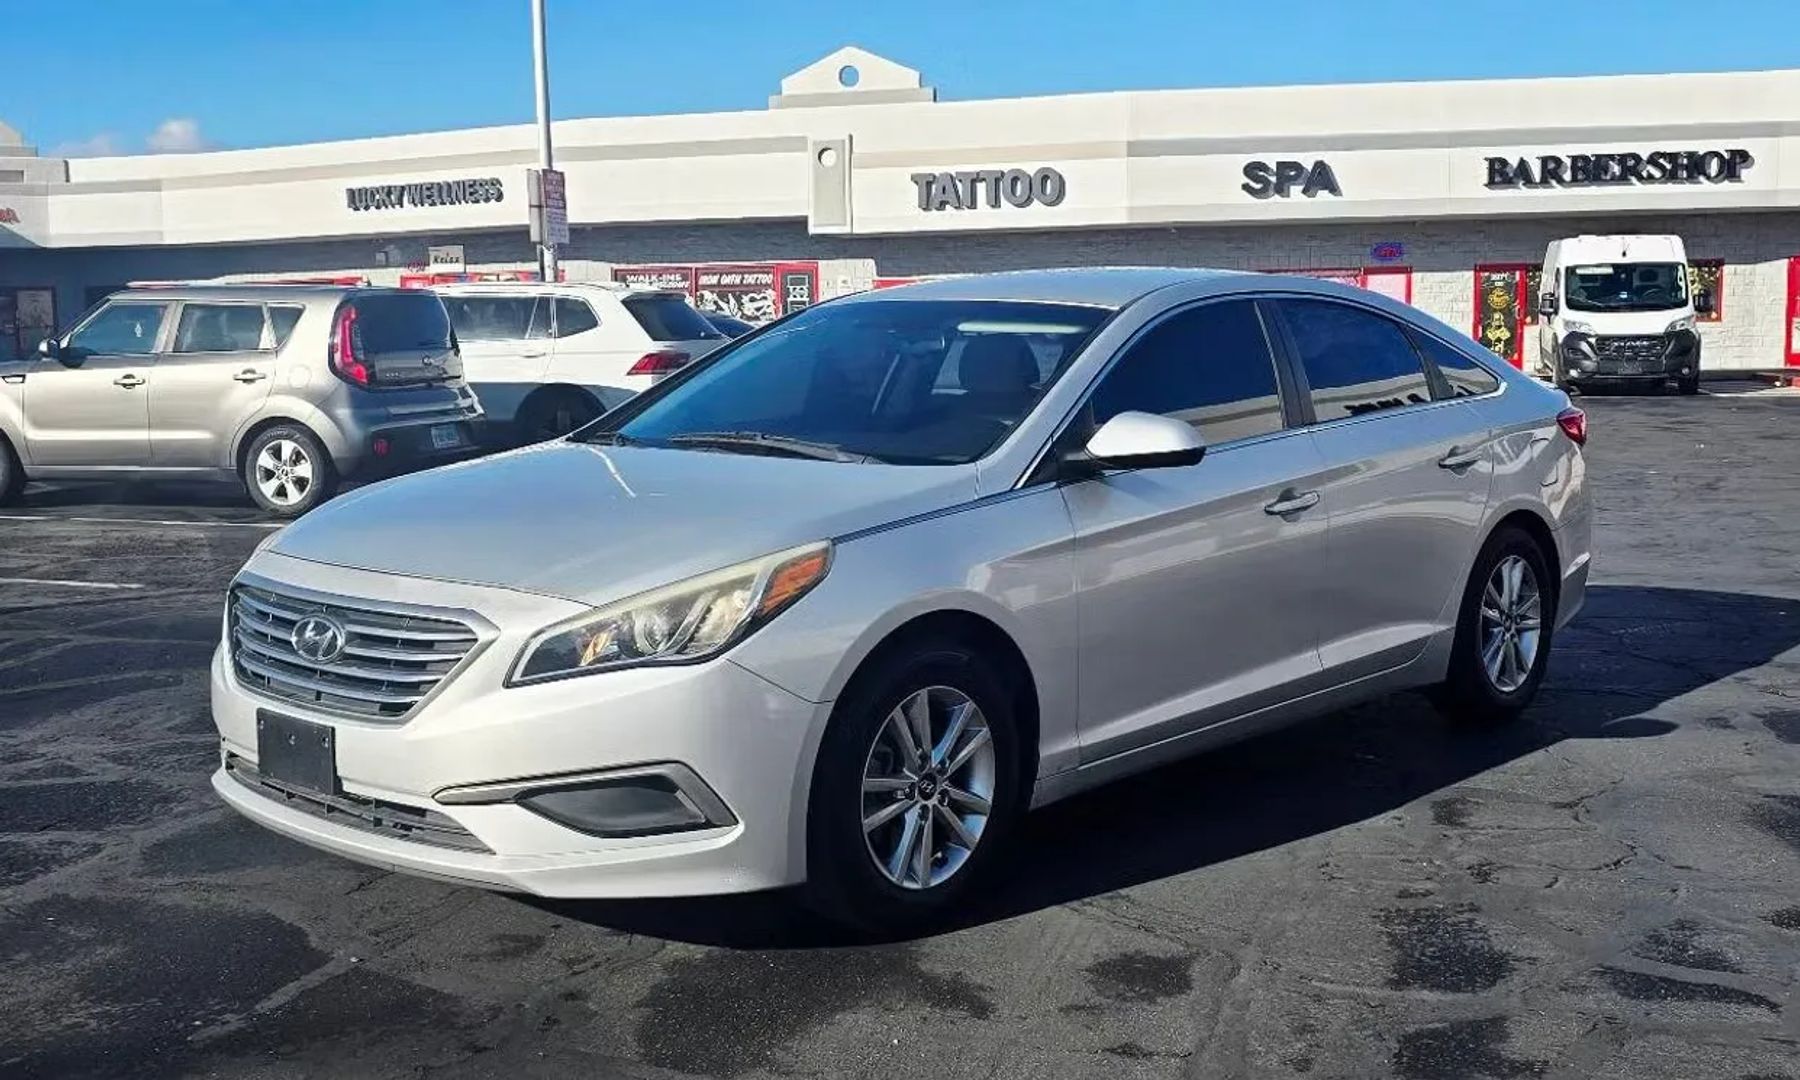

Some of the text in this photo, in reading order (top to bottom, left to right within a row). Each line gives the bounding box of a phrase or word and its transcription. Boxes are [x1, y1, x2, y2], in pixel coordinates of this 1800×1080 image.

[911, 166, 1066, 212] TATTOO
[1241, 159, 1343, 199] SPA
[1484, 148, 1755, 190] BARBERSHOP
[346, 177, 504, 211] LUCKY WELLNESS
[742, 273, 773, 285] TATTOO
